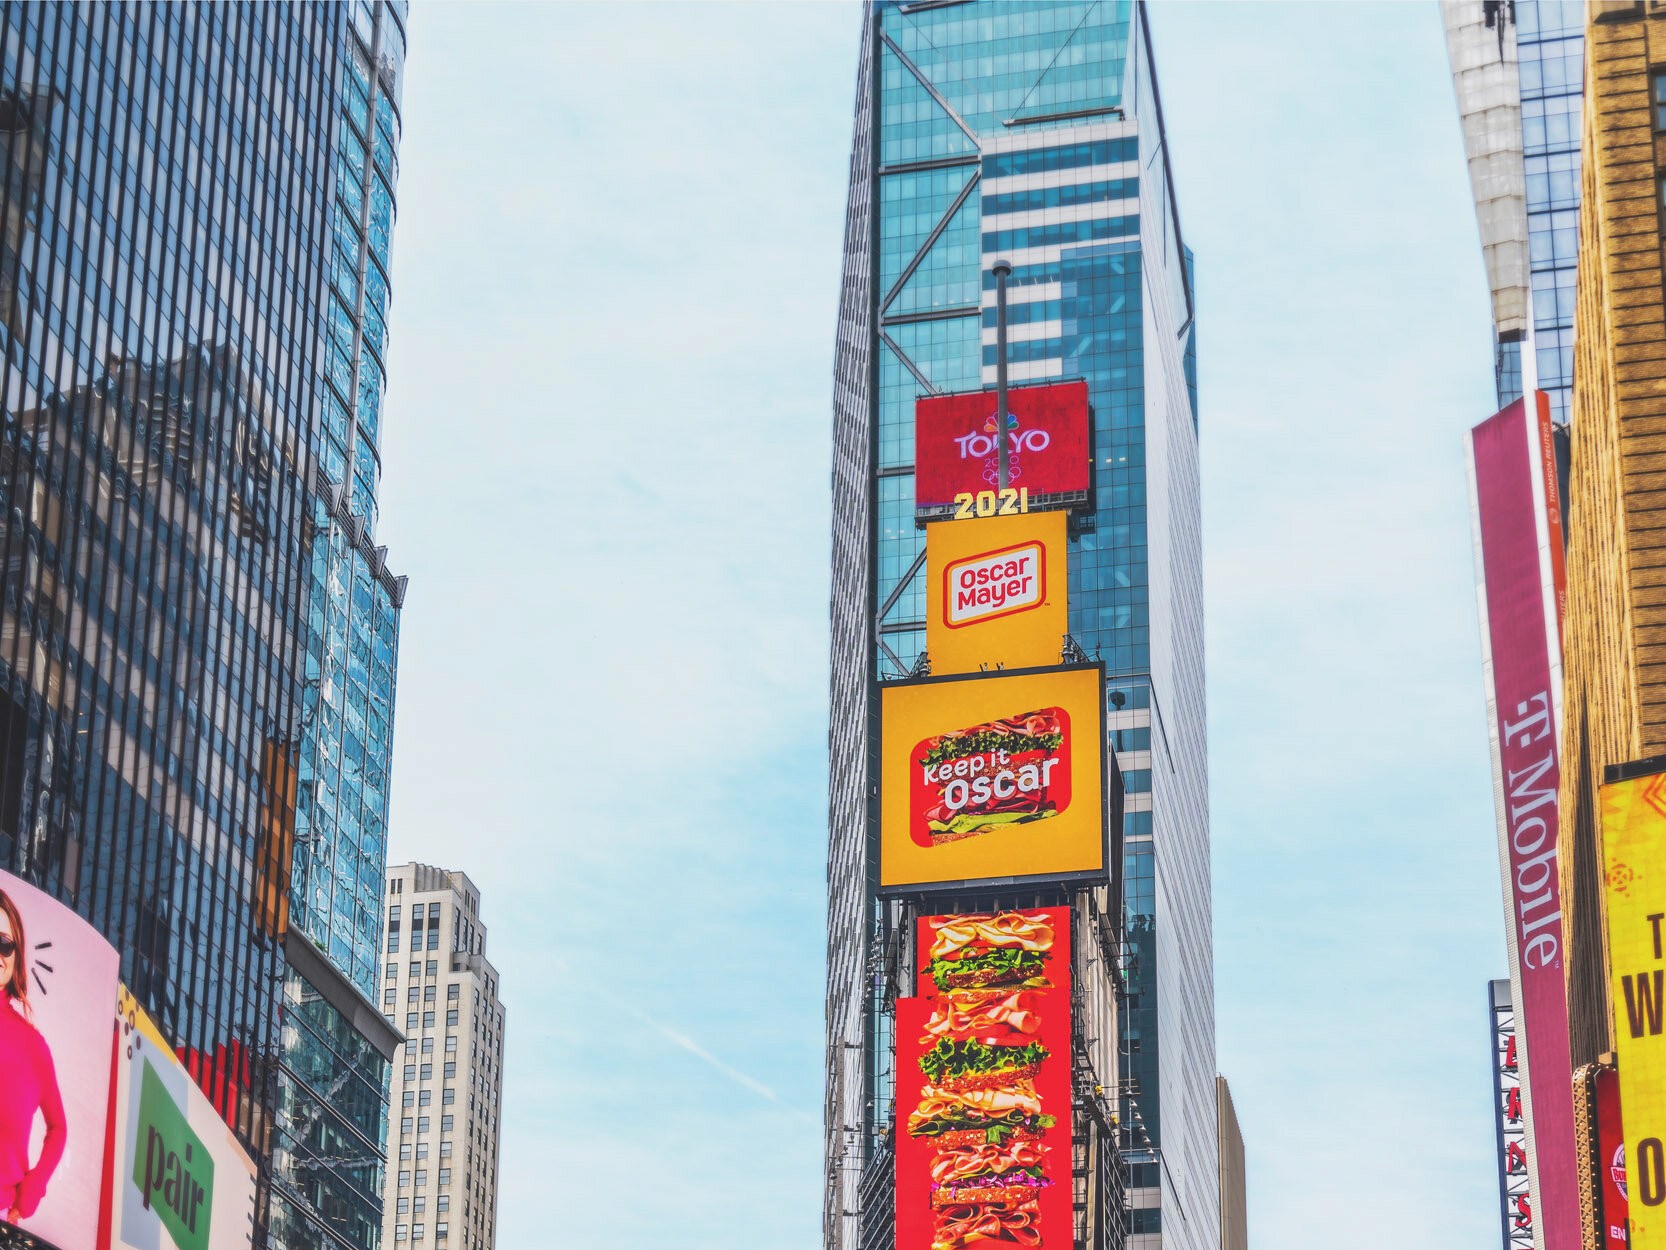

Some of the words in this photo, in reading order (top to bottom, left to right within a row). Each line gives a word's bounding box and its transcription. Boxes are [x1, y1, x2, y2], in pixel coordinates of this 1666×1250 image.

[985, 455, 1019, 468] 200
[954, 486, 1028, 519] 2021
[960, 556, 1030, 589] Oscar
[958, 576, 1032, 610] Mayer
[924, 755, 985, 786] Keep
[990, 748, 1011, 767] it
[945, 758, 1059, 810] Oscar
[143, 1124, 205, 1235] pair
